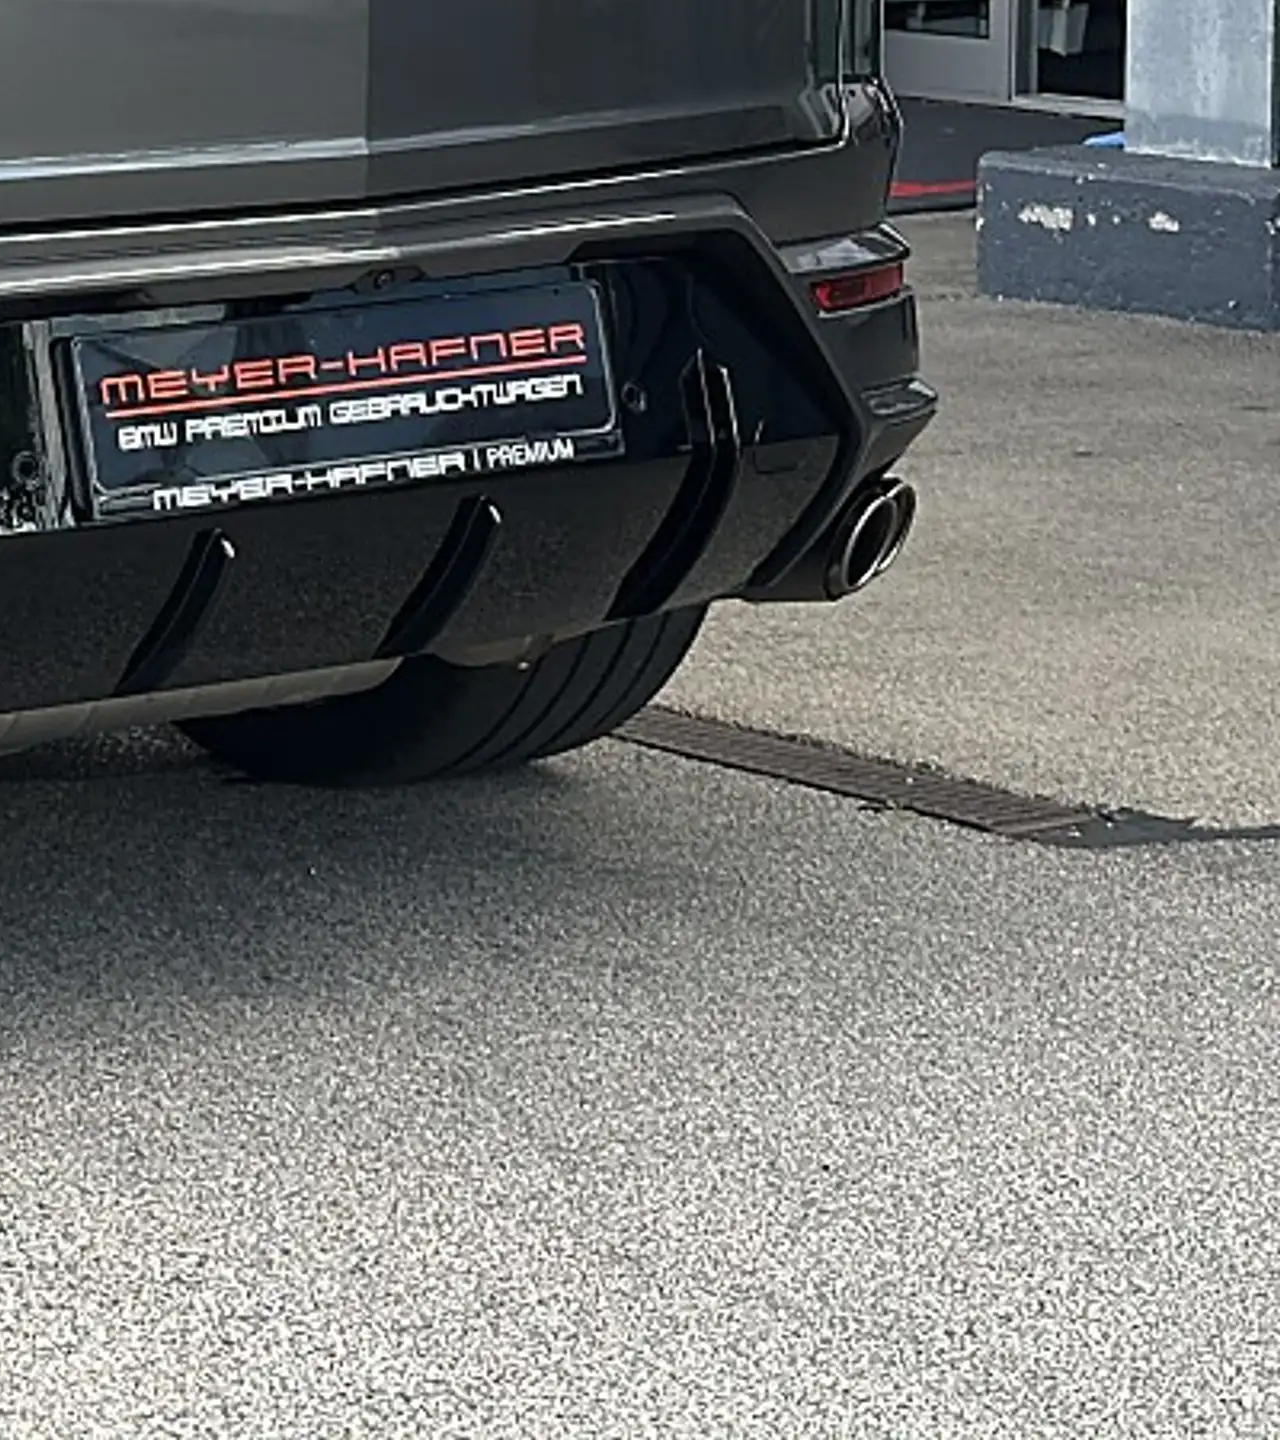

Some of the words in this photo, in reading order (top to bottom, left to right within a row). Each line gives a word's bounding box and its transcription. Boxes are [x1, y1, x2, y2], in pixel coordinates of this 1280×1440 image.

[100, 323, 586, 406] MEYER-HAFNER
[118, 421, 178, 452] BMW
[185, 406, 322, 443] PREMIUM
[329, 373, 584, 425] GEBRAUCHTWAGEN
[153, 451, 466, 512] MEYER-HAFNER
[486, 437, 575, 470] PREMIUM
